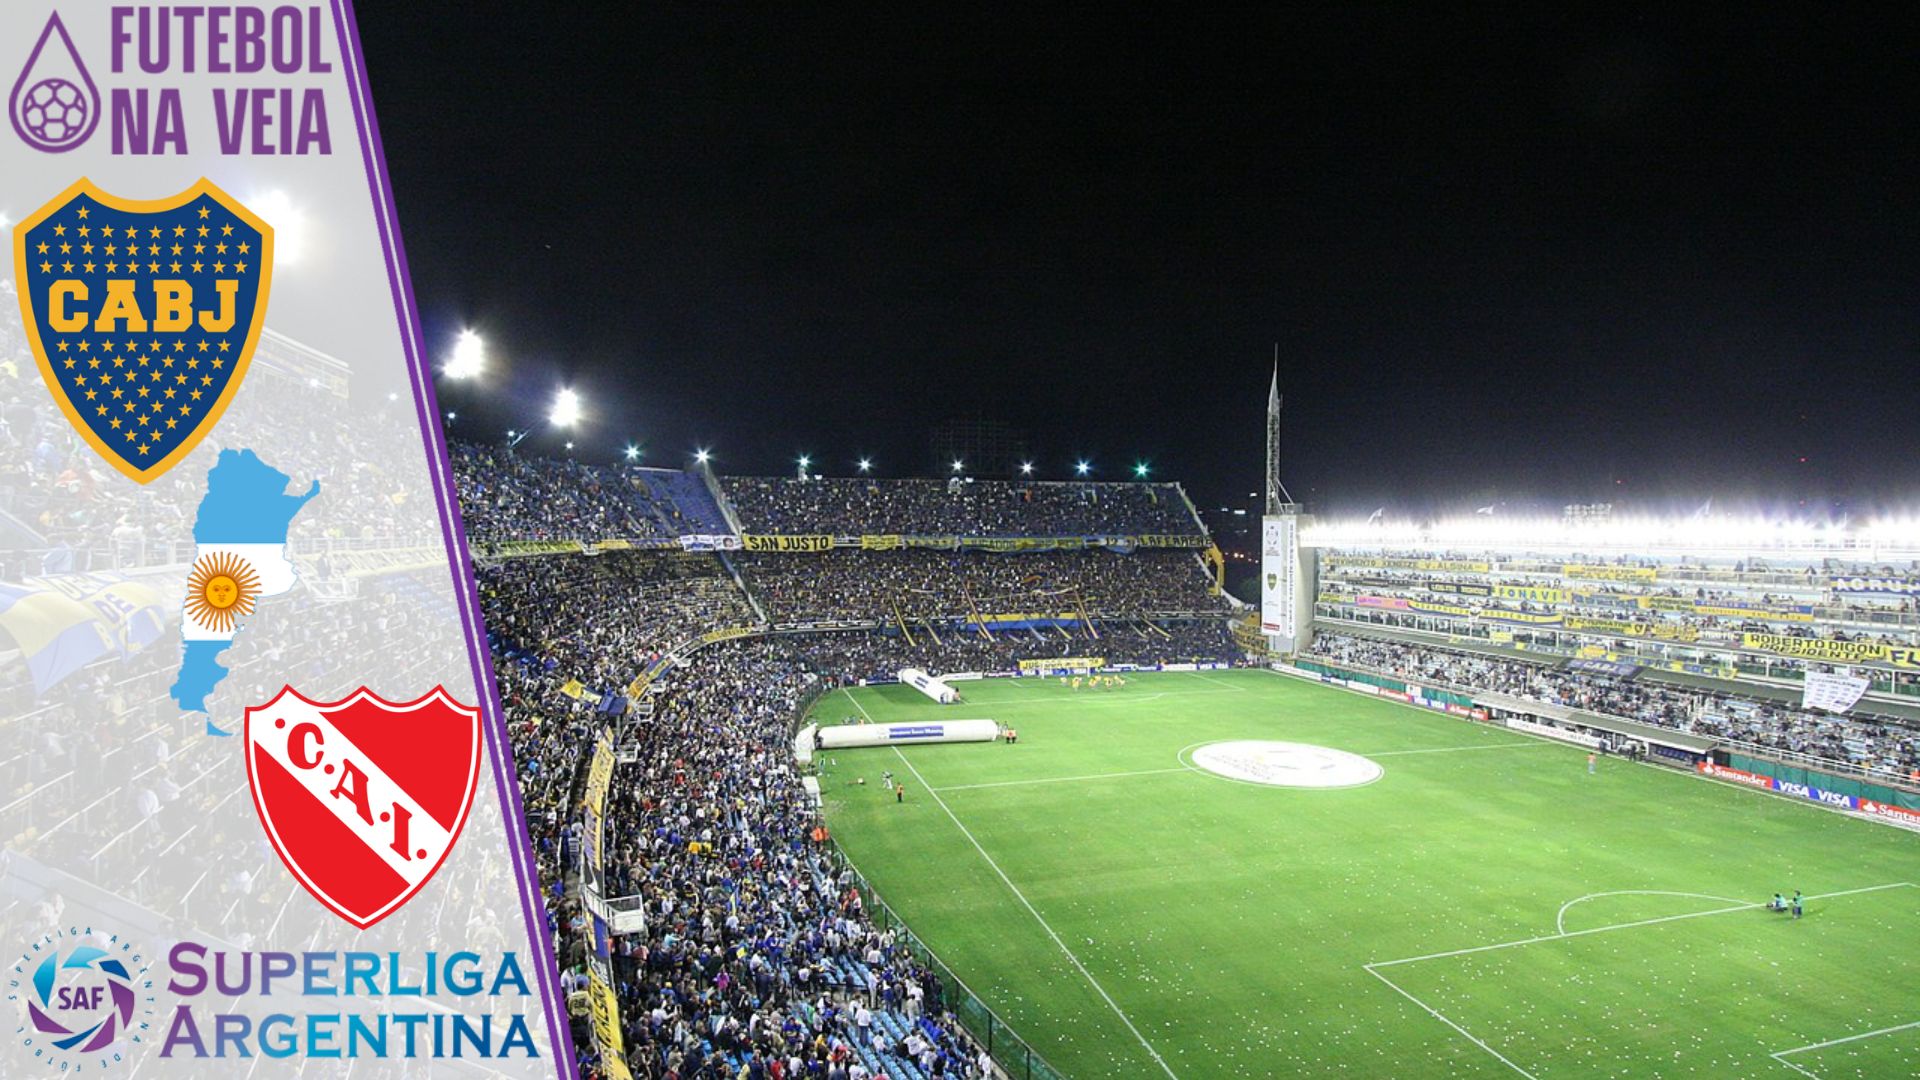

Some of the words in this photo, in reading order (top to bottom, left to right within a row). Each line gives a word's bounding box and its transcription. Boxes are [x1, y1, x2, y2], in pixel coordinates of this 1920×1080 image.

[751, 536, 779, 550] SAN
[783, 536, 828, 550] JUSTO
[1751, 634, 1825, 649] ROBERTO
[1829, 641, 1881, 655] DIGON
[1714, 765, 1767, 787] Santander
[1778, 780, 1811, 798] VISA
[1817, 789, 1851, 808] VISA
